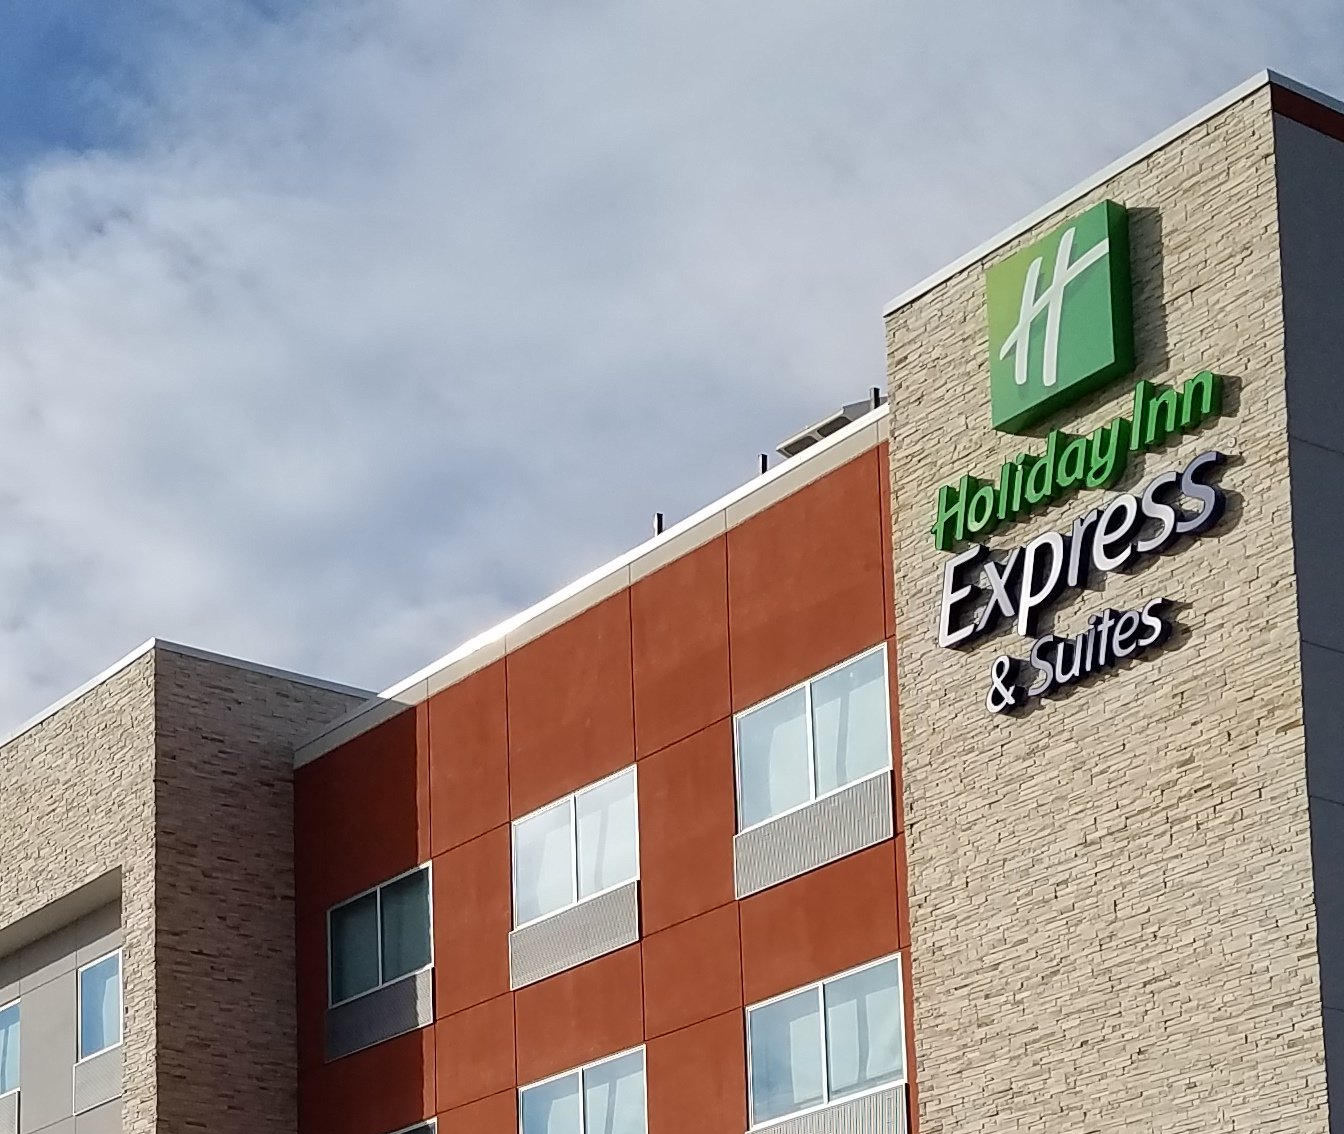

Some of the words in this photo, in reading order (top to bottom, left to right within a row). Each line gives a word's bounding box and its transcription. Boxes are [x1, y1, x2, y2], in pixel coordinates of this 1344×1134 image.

[931, 417, 1126, 550] Holiday
[1128, 370, 1219, 451] Inn
[938, 450, 1220, 648] Express
[985, 655, 1017, 713] &
[1027, 597, 1164, 697] Suites
